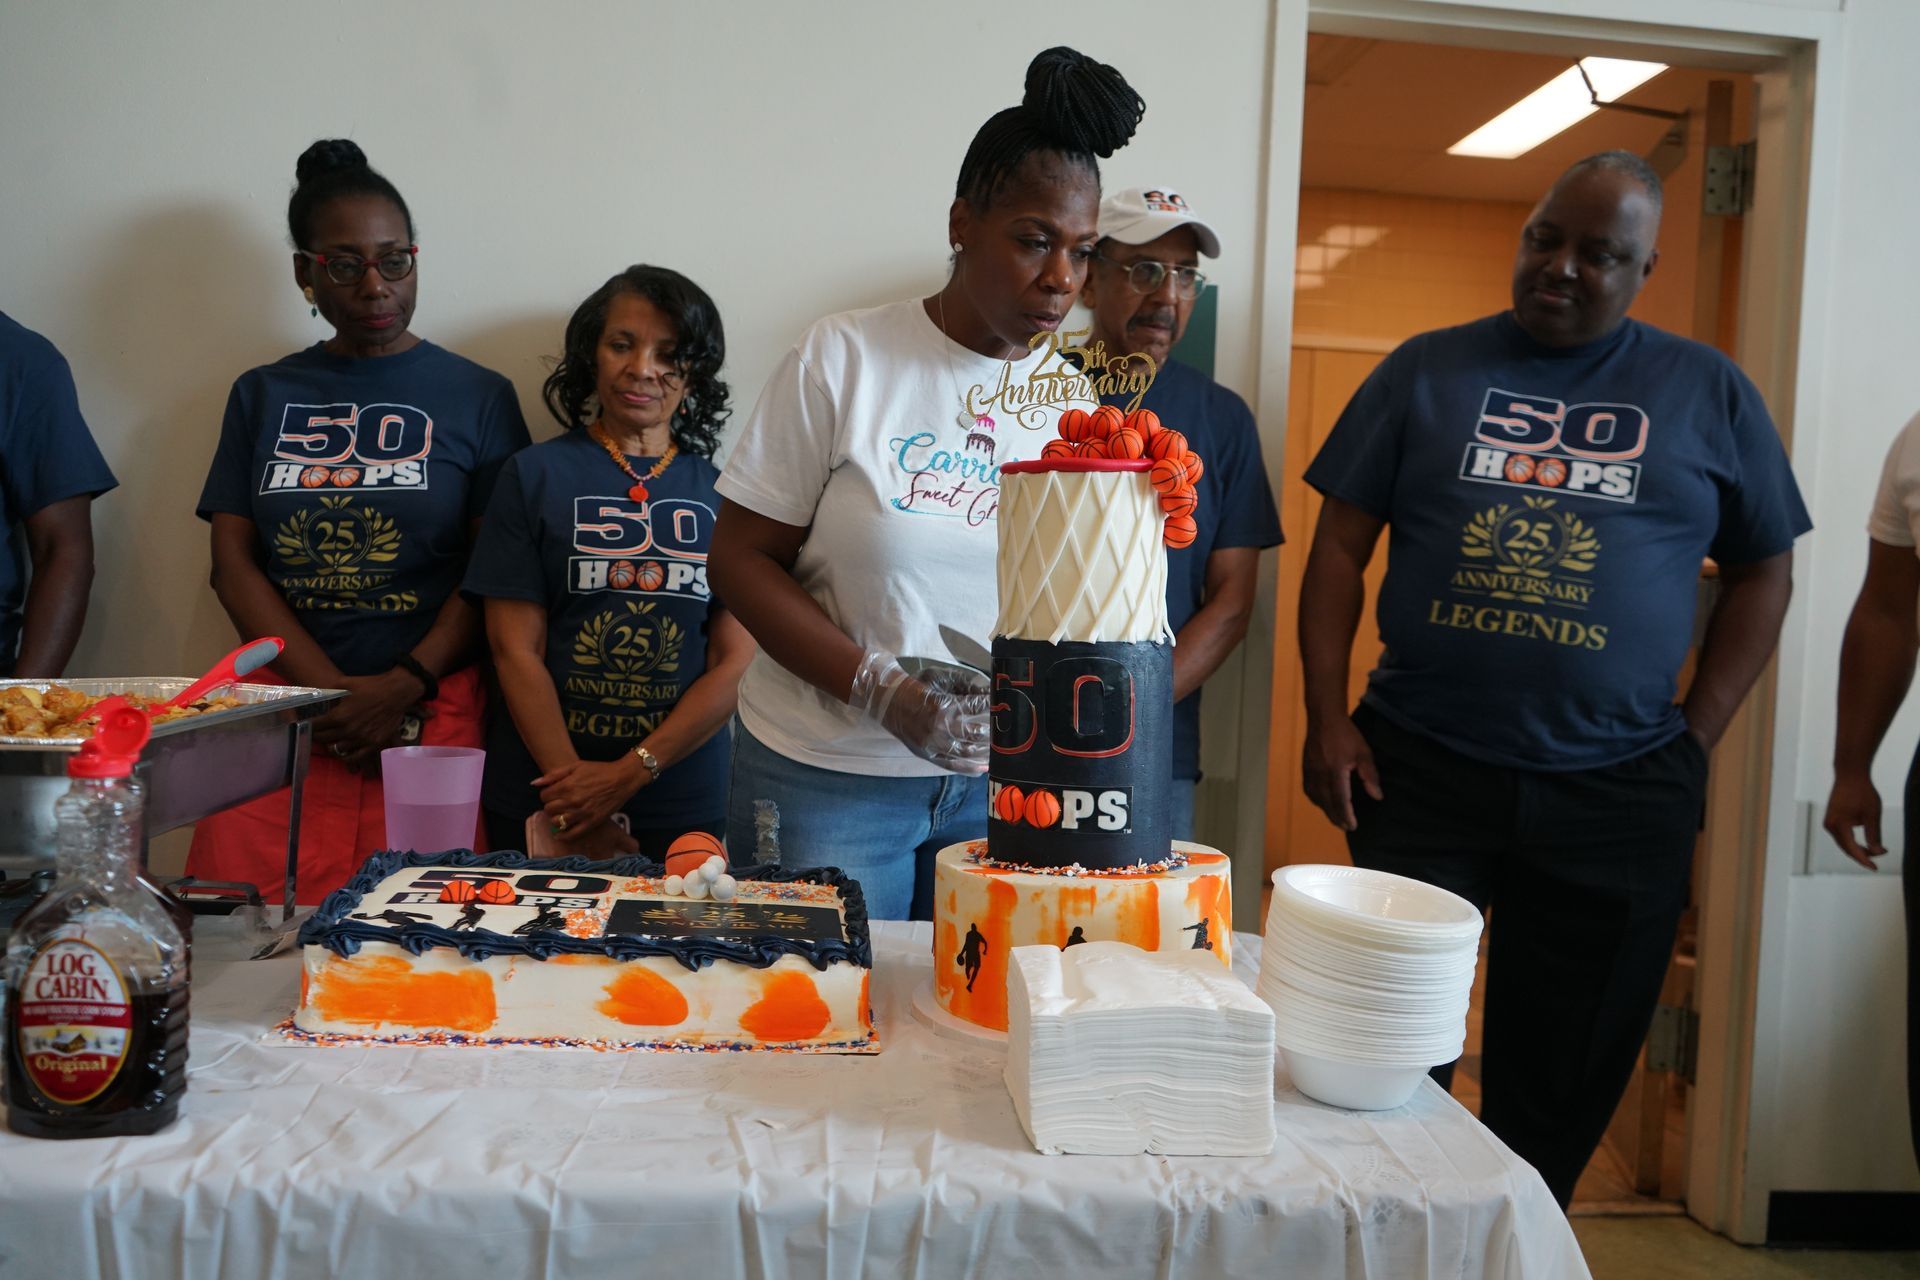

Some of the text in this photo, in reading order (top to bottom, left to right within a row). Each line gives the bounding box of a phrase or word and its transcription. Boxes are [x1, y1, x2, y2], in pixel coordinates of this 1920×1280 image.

[1028, 326, 1108, 380] 25th
[967, 352, 1157, 420] Anniversary
[274, 402, 432, 465] 50
[1474, 387, 1650, 461] 50
[268, 463, 422, 488] HOOPS
[1471, 447, 1633, 496] HOOPS
[900, 471, 975, 511] Sweet
[573, 496, 717, 561] 50
[281, 574, 393, 591] ANNIVERSAR
[1451, 570, 1595, 603] ANNIVERSARY
[1428, 600, 1609, 651] LEGENDS
[564, 677, 681, 700] ANNIVERSARY
[567, 708, 670, 738] EGEN
[990, 656, 1136, 758] 50
[409, 870, 613, 895] 50
[47, 953, 96, 976] LOG
[35, 976, 111, 1001] CABIN
[35, 1056, 107, 1073] Original
